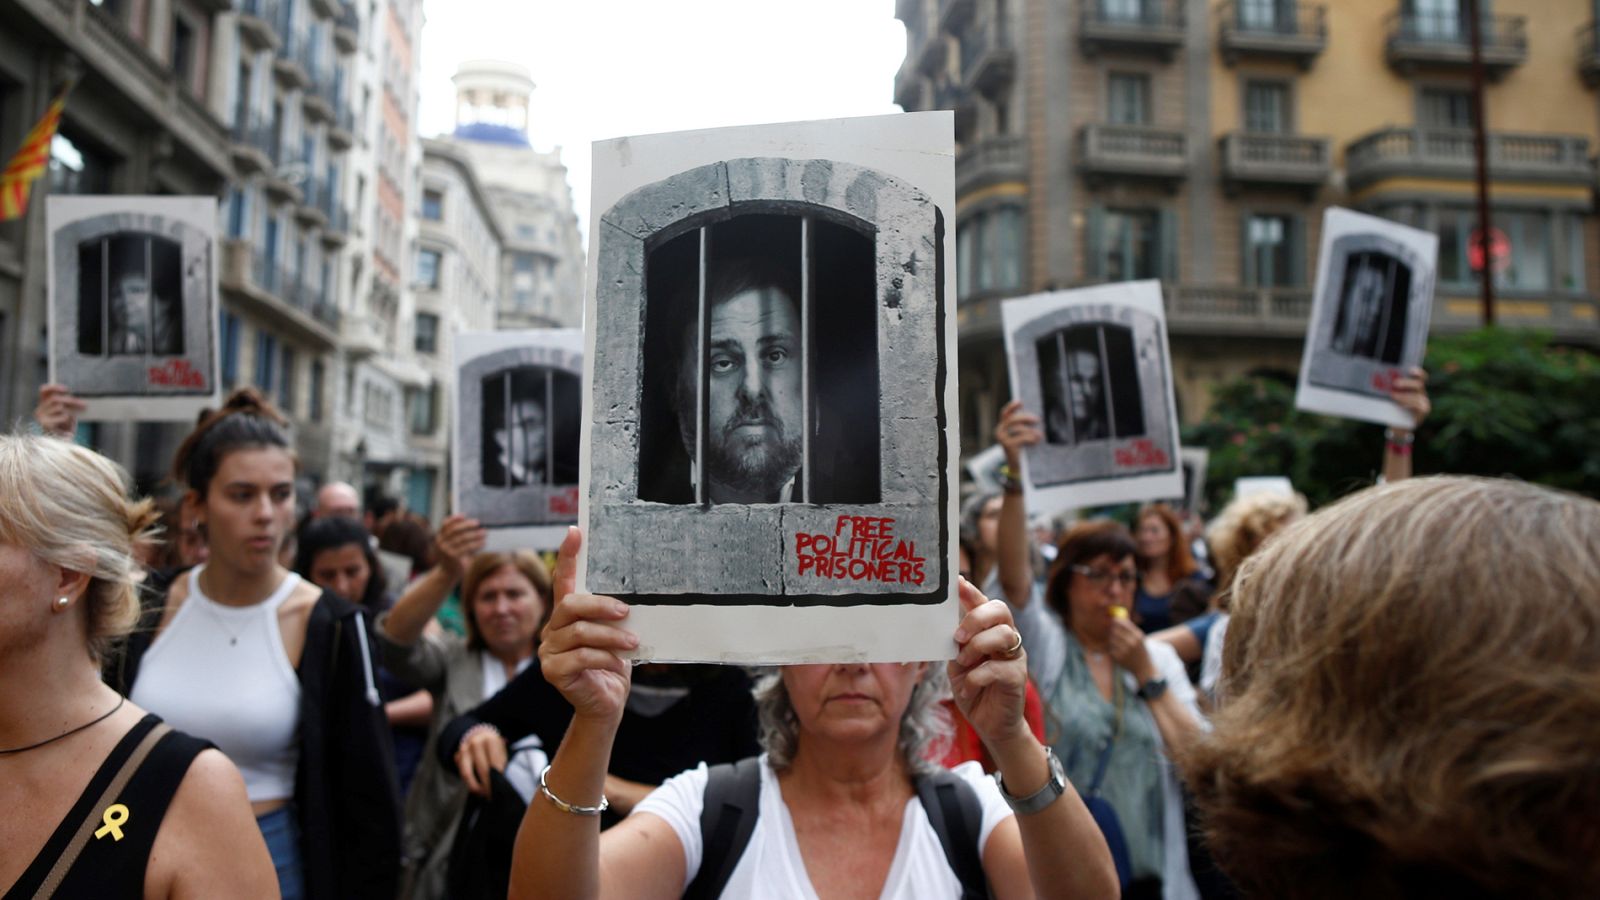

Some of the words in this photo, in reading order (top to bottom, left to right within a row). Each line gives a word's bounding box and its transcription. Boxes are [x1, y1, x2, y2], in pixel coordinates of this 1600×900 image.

[835, 515, 896, 540] FREE
[795, 533, 927, 562] POLITICAL
[797, 554, 926, 586] PRISONERS
